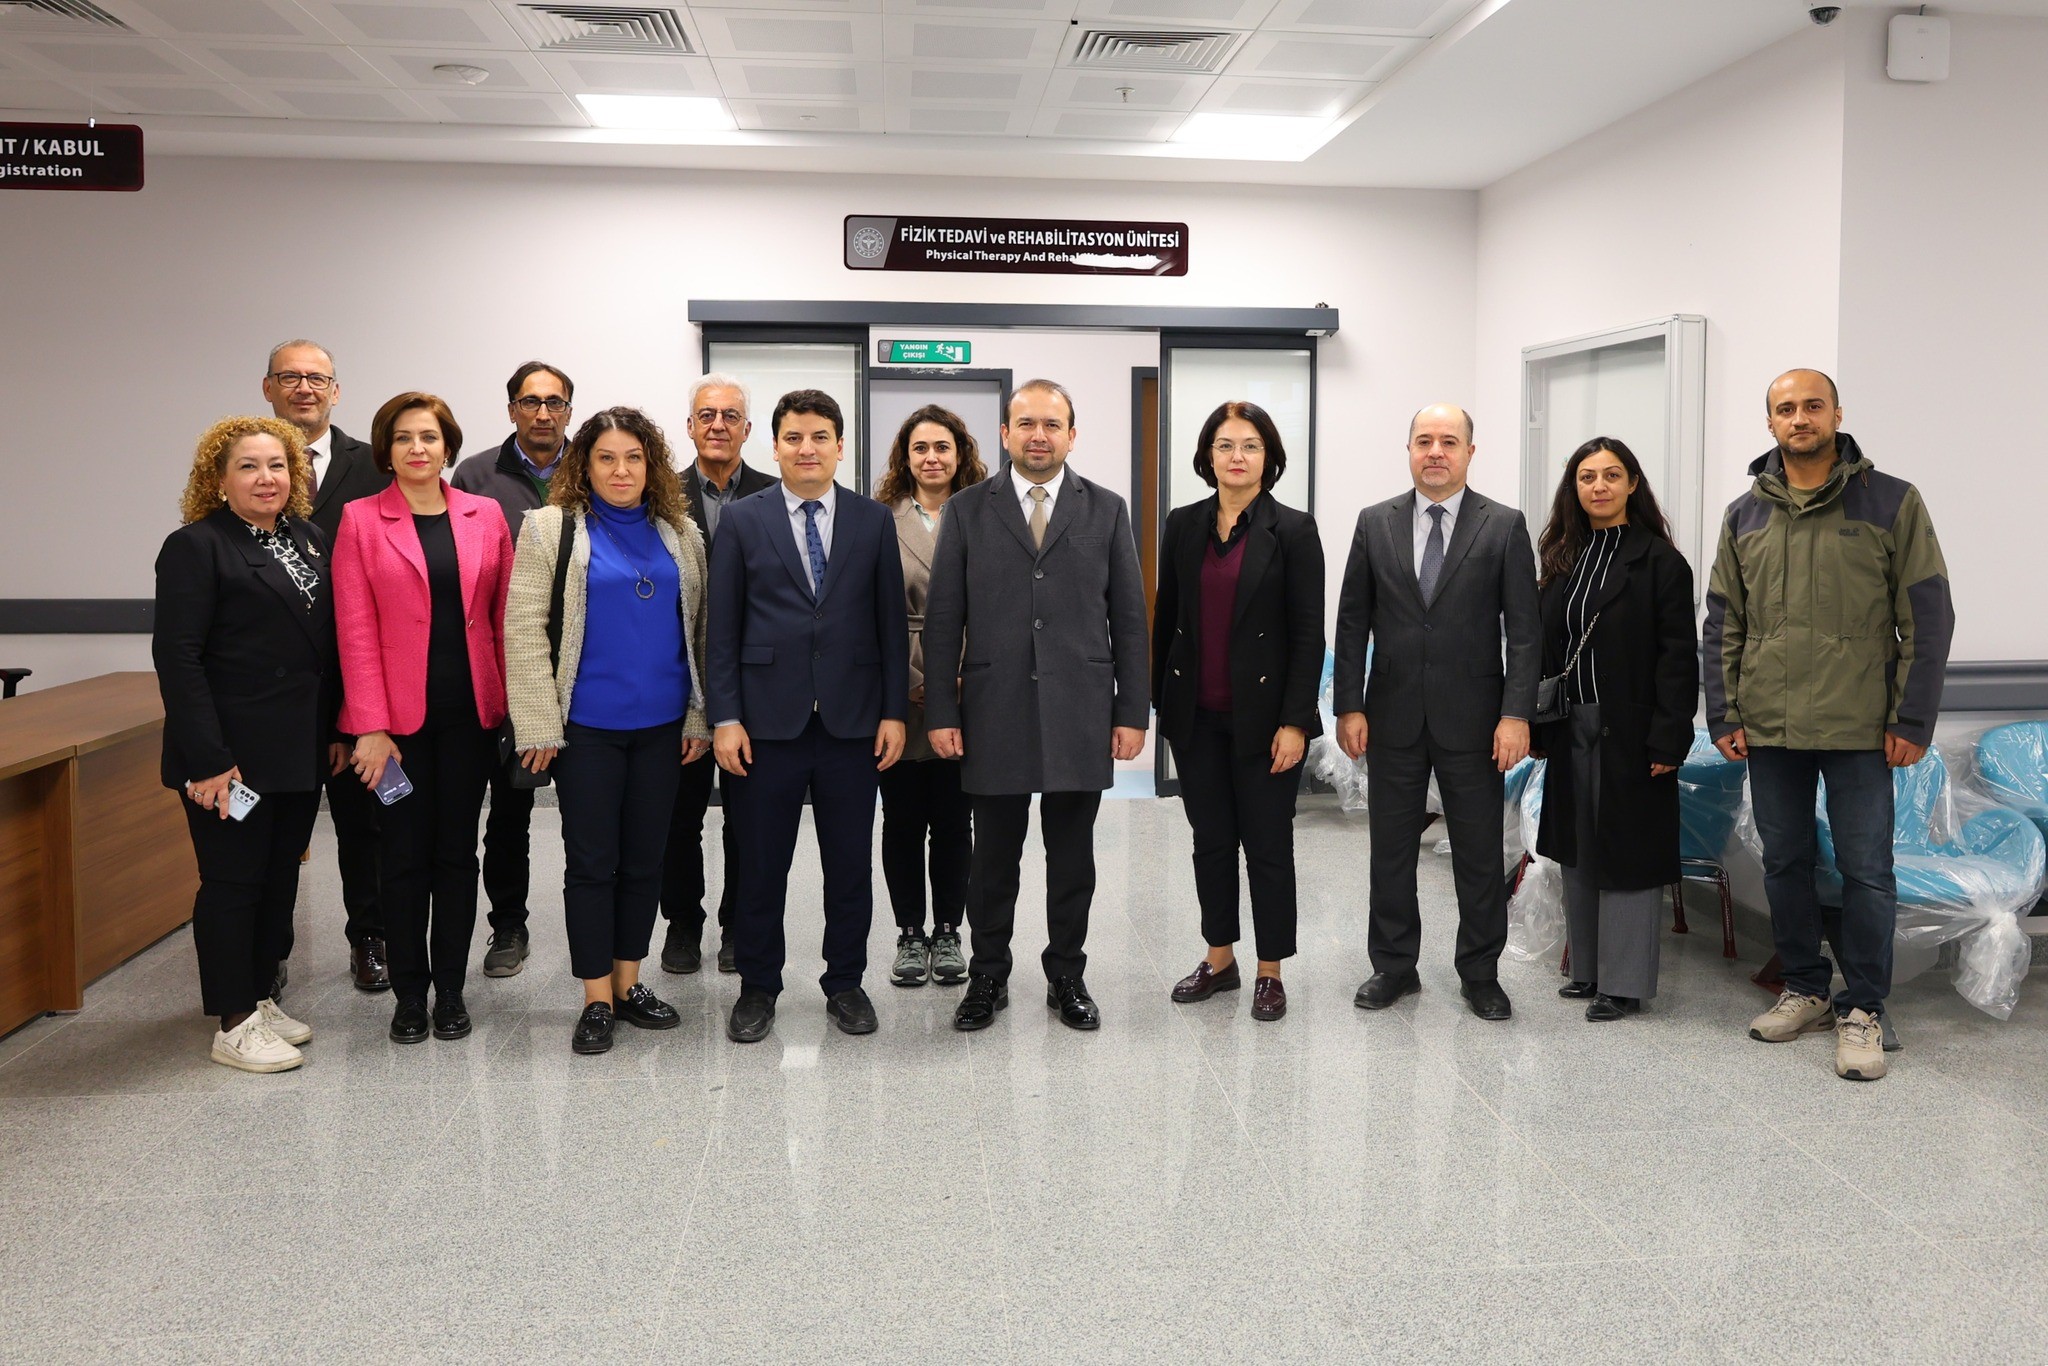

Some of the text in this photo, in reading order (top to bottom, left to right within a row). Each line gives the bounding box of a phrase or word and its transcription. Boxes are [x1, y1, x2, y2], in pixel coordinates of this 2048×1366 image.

[33, 139, 105, 156] KABUL
[900, 225, 1179, 248] FİZİK TEDAVİ ve REHABİLİTASYON ÜNİTESİ
[926, 249, 973, 262] Physical
[974, 250, 1021, 264] Therapy
[1023, 251, 1046, 262] And
[900, 343, 929, 351] YANGIN
